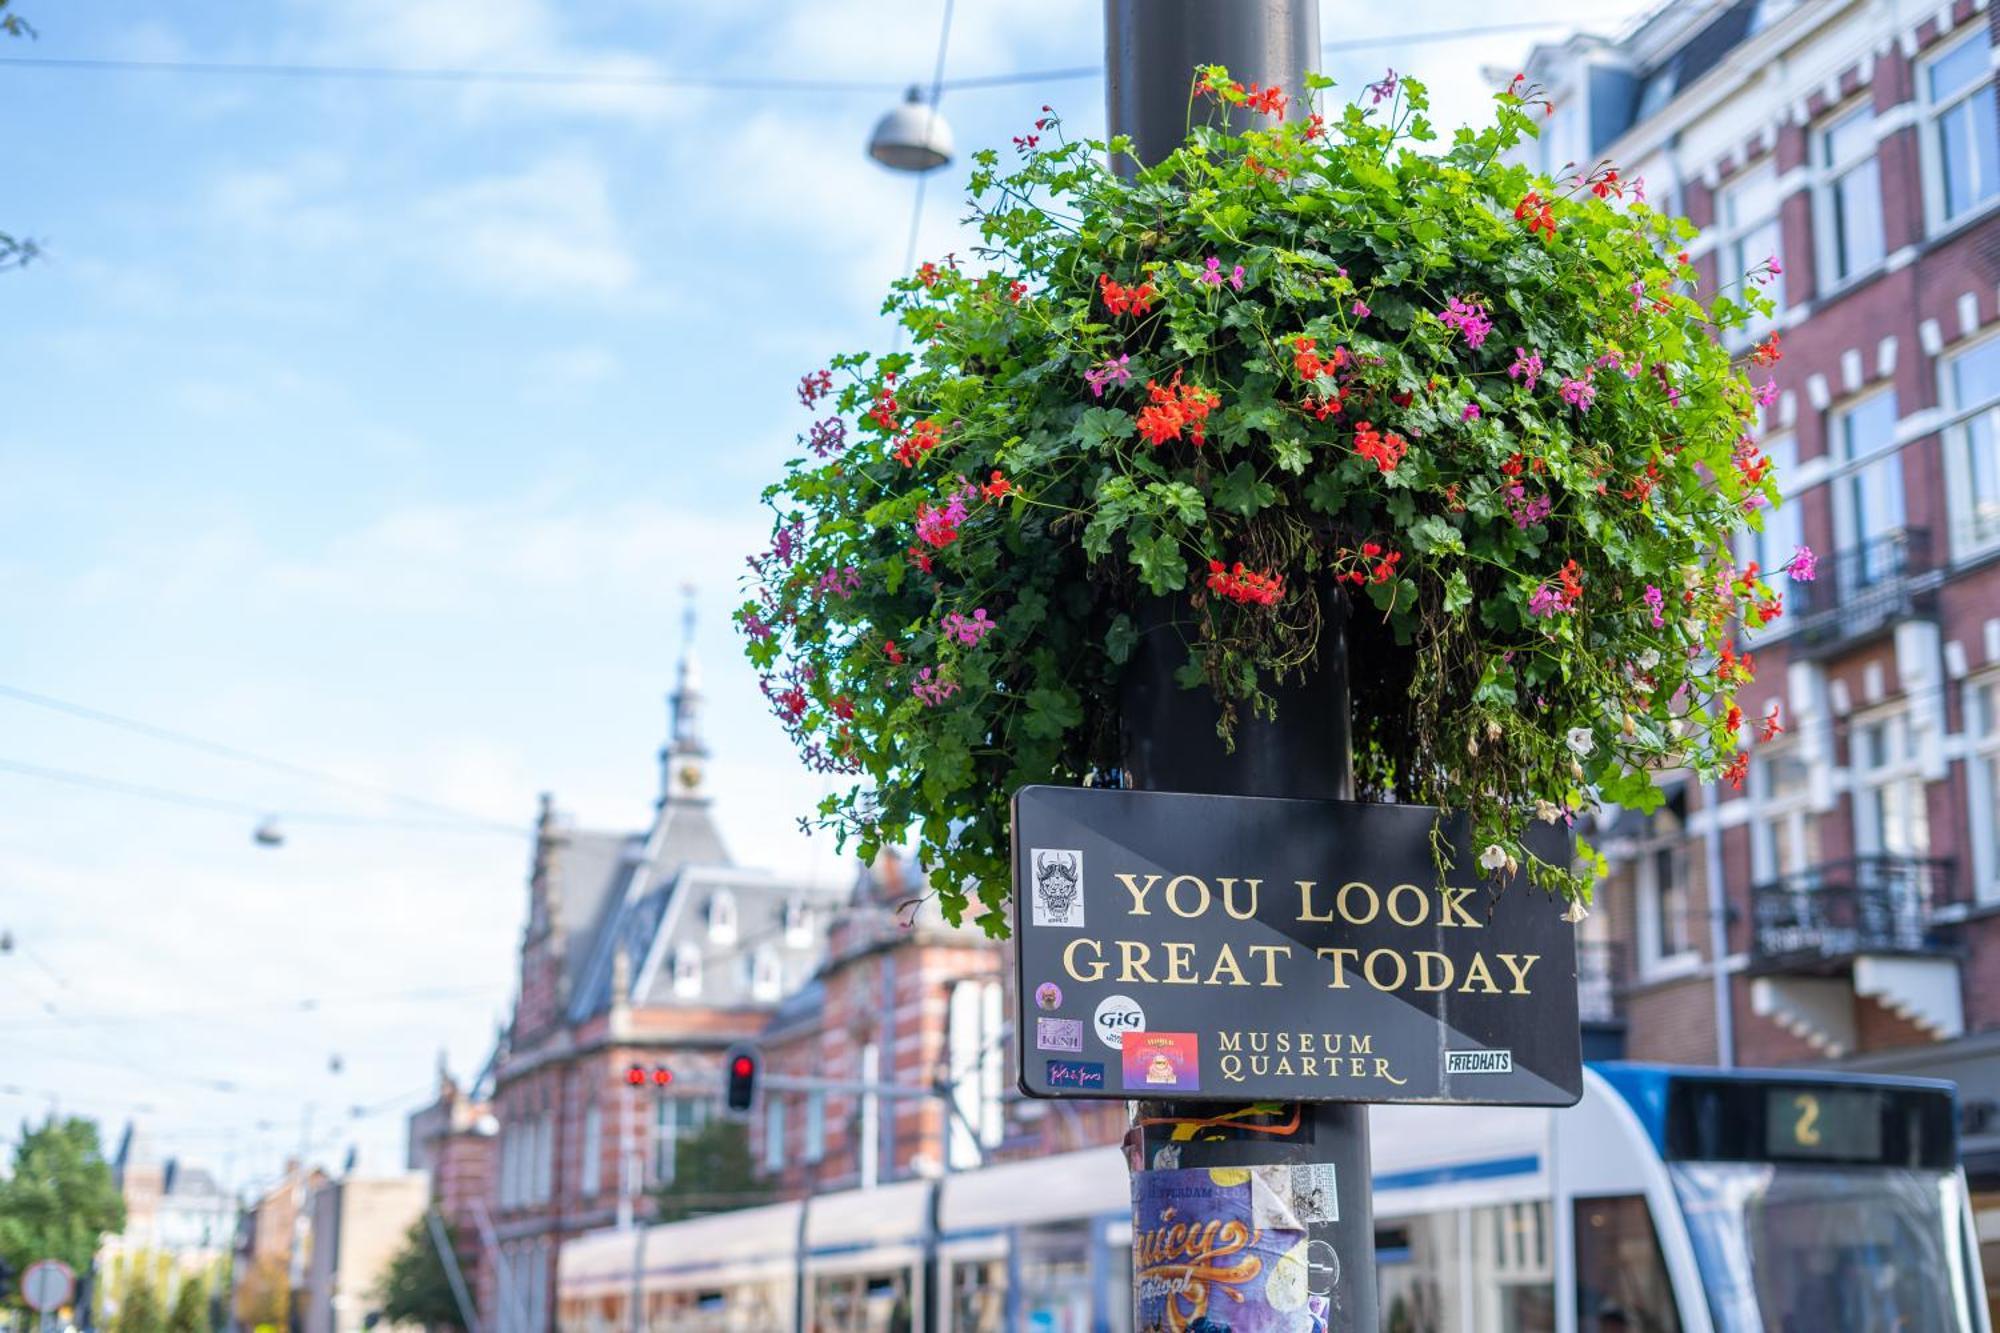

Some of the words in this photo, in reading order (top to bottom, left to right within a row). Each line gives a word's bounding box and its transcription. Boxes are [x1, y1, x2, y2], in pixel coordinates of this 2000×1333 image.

[1114, 873, 1264, 921] YOU
[1294, 880, 1484, 928] LOOK
[1063, 937, 1292, 986] GREAT
[1316, 947, 1541, 995] TODAY
[1217, 1030, 1374, 1055] MUSEUM
[1448, 1053, 1509, 1071] FRIEDHATS
[1220, 1054, 1408, 1085] QUARTER
[1794, 1093, 1820, 1146] 2
